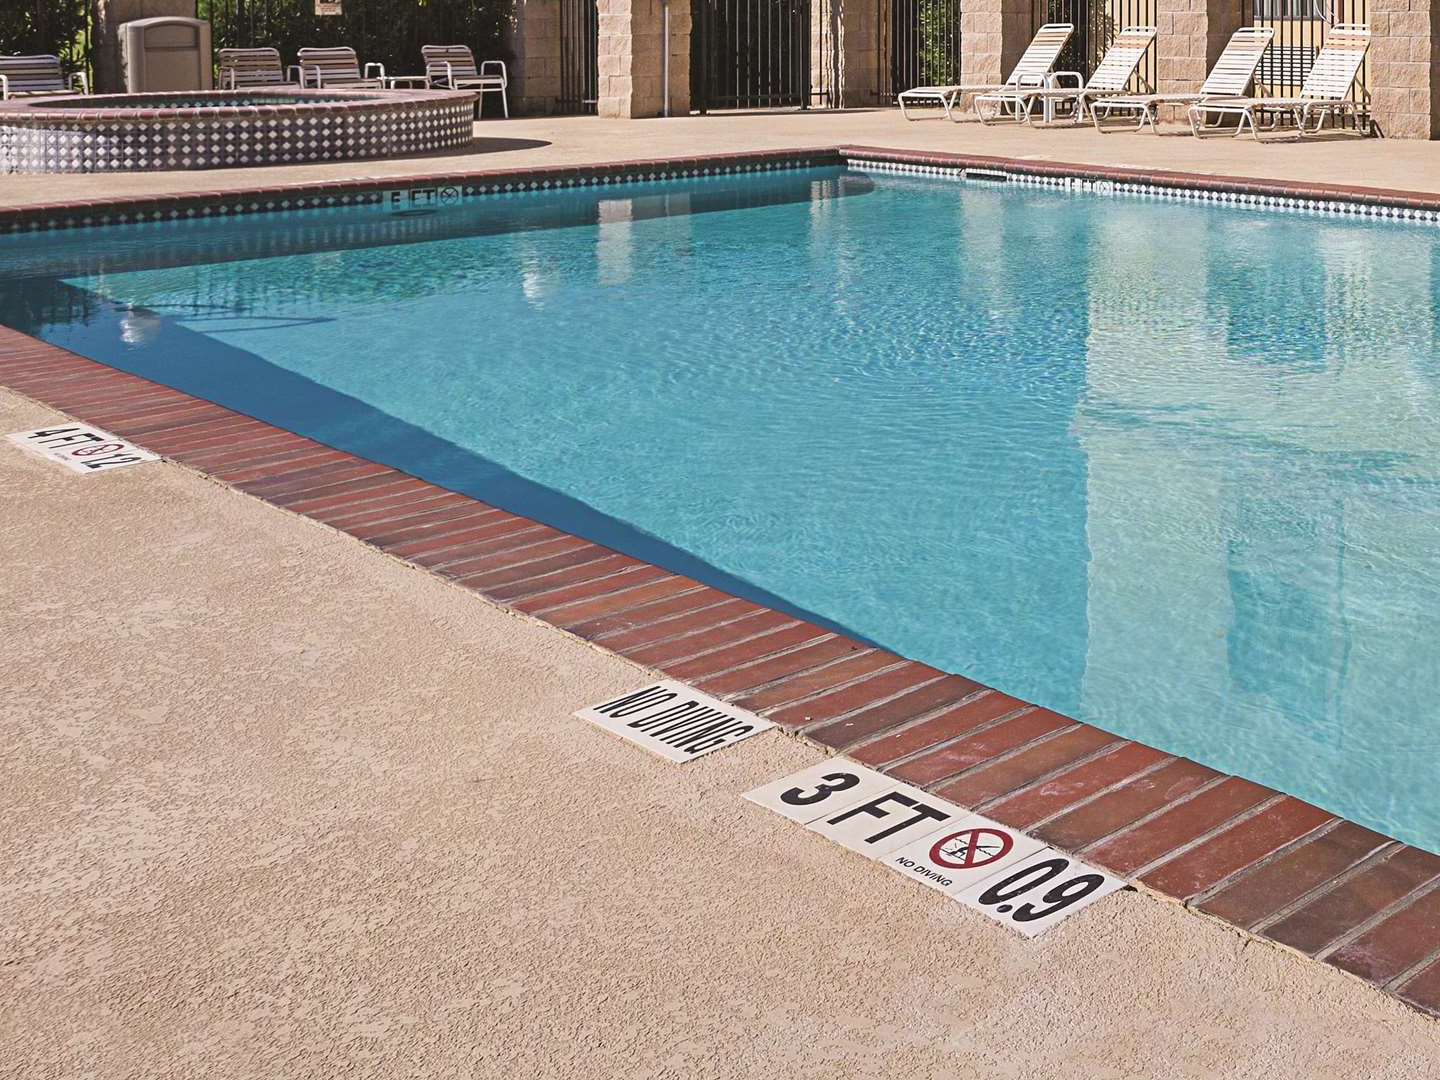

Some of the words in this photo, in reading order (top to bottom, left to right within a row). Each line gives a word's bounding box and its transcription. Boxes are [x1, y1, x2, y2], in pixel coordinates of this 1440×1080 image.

[27, 427, 80, 439] 4
[37, 432, 105, 449] FT
[593, 685, 678, 718] NO
[627, 700, 754, 754] DIVING
[780, 772, 861, 806] 3
[826, 791, 952, 845] FT
[978, 858, 1105, 922] 0.9
[896, 856, 916, 869] NO
[914, 865, 953, 887] DIVING
